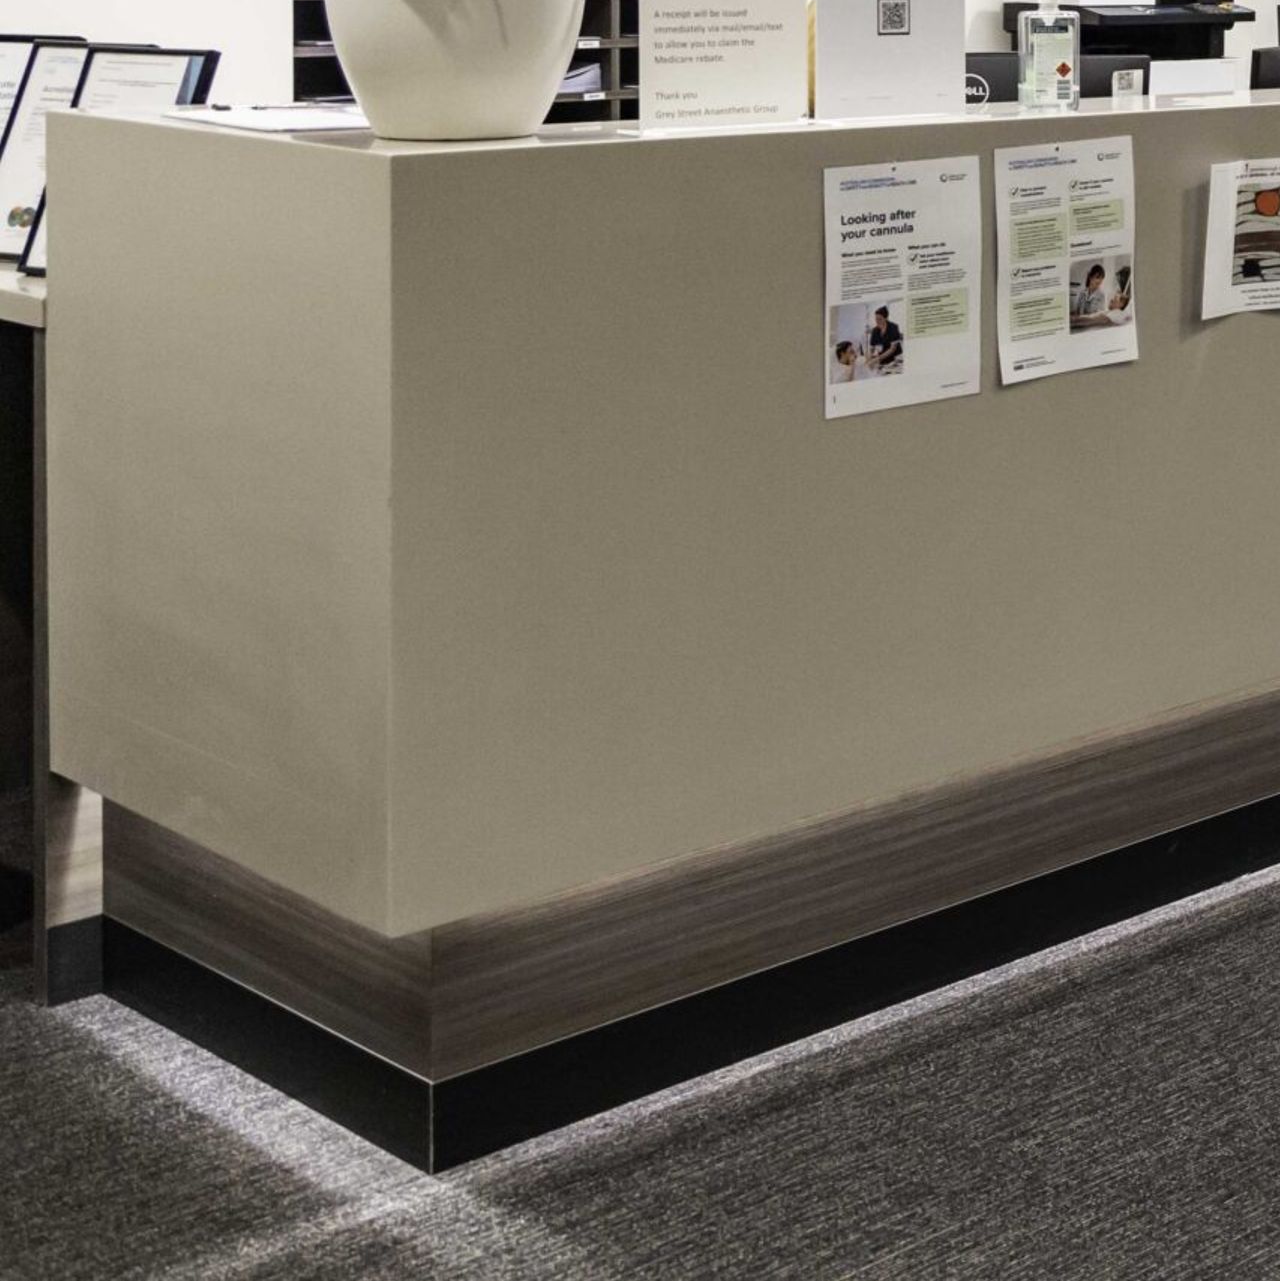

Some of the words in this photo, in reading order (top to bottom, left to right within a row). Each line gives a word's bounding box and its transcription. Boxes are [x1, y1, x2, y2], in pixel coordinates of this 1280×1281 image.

[654, 10, 660, 18] A
[662, 10, 691, 19] receipt
[722, 9, 748, 17] issued
[654, 25, 706, 34] immediately
[665, 41, 687, 49] allow
[691, 41, 705, 49] you
[718, 39, 740, 47] claim
[654, 55, 693, 63] Medicare
[655, 92, 679, 100] Thank
[682, 92, 698, 101] you
[840, 211, 887, 226] Looking
[889, 208, 916, 221] after
[840, 229, 867, 242] your
[869, 223, 915, 238] cannula
